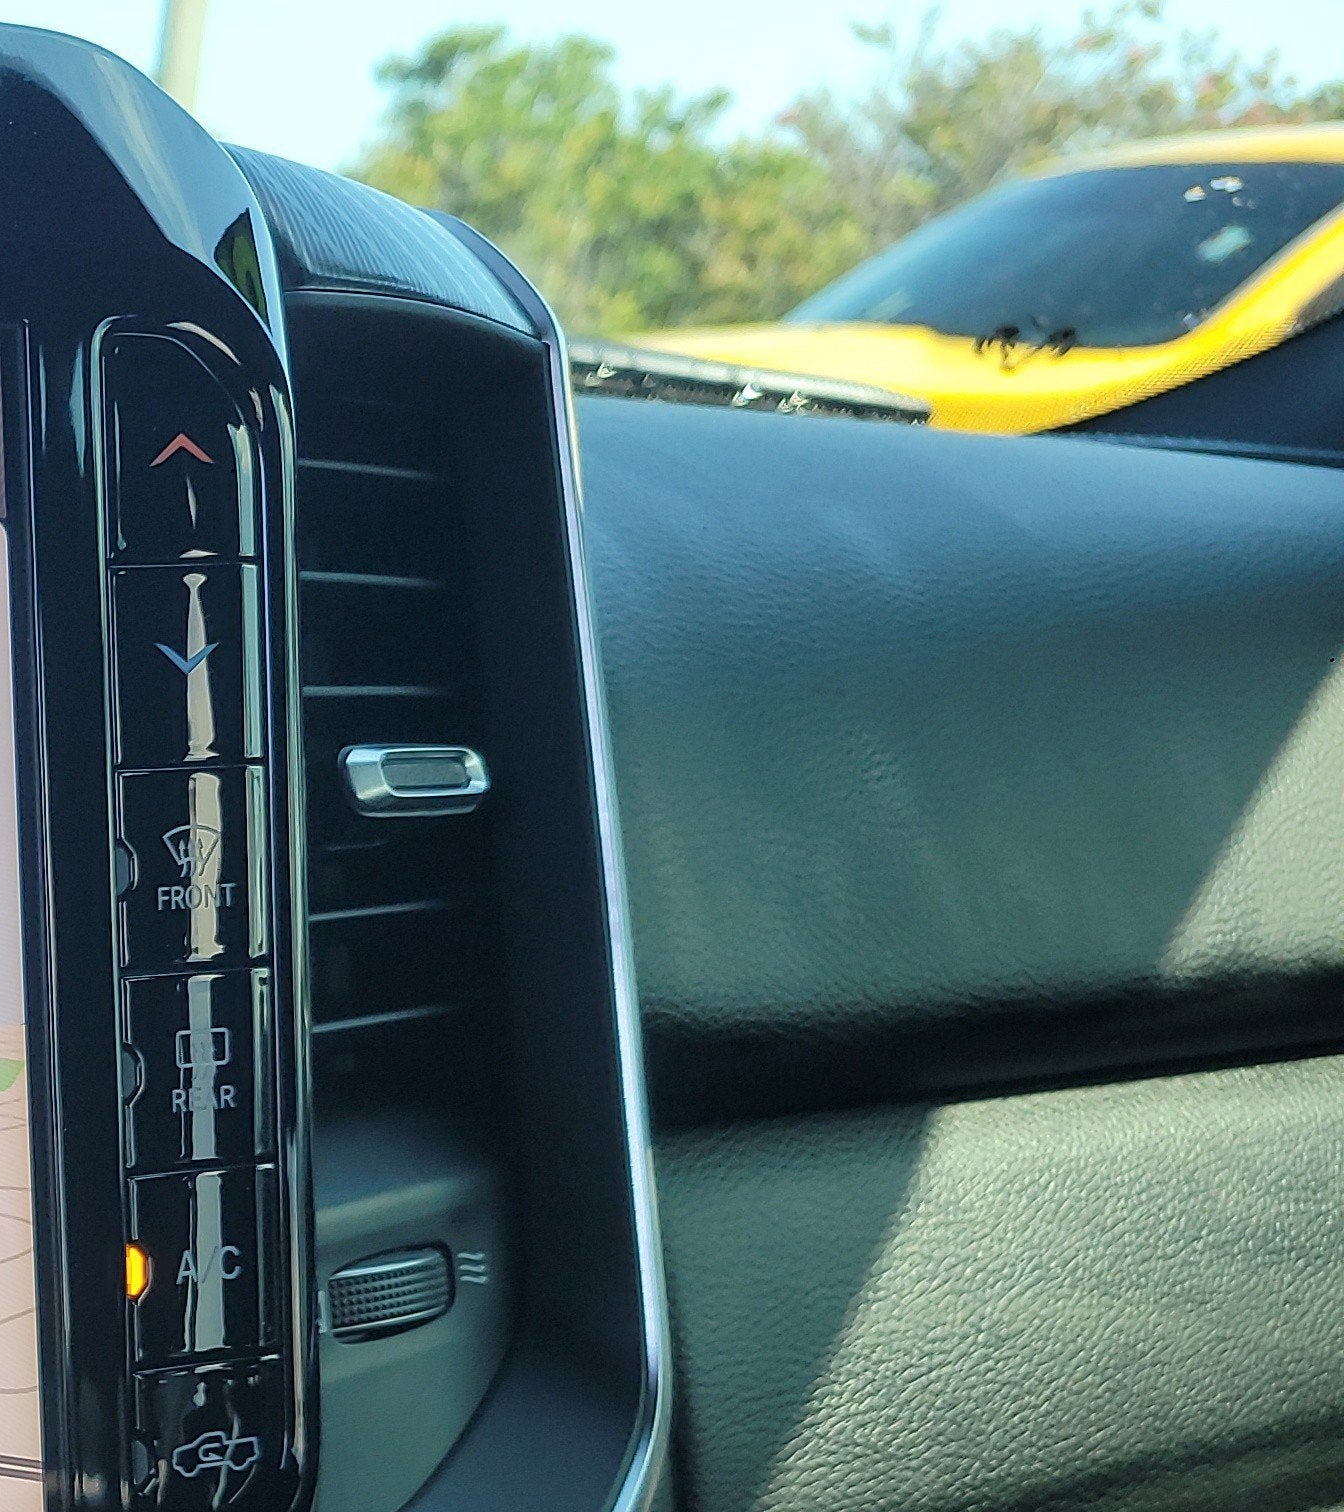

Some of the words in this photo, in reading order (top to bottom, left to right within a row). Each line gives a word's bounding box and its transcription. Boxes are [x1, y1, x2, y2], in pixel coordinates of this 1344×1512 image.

[157, 882, 237, 911] FRONT
[171, 1085, 237, 1114] REAR
[175, 1245, 243, 1286] A/C
